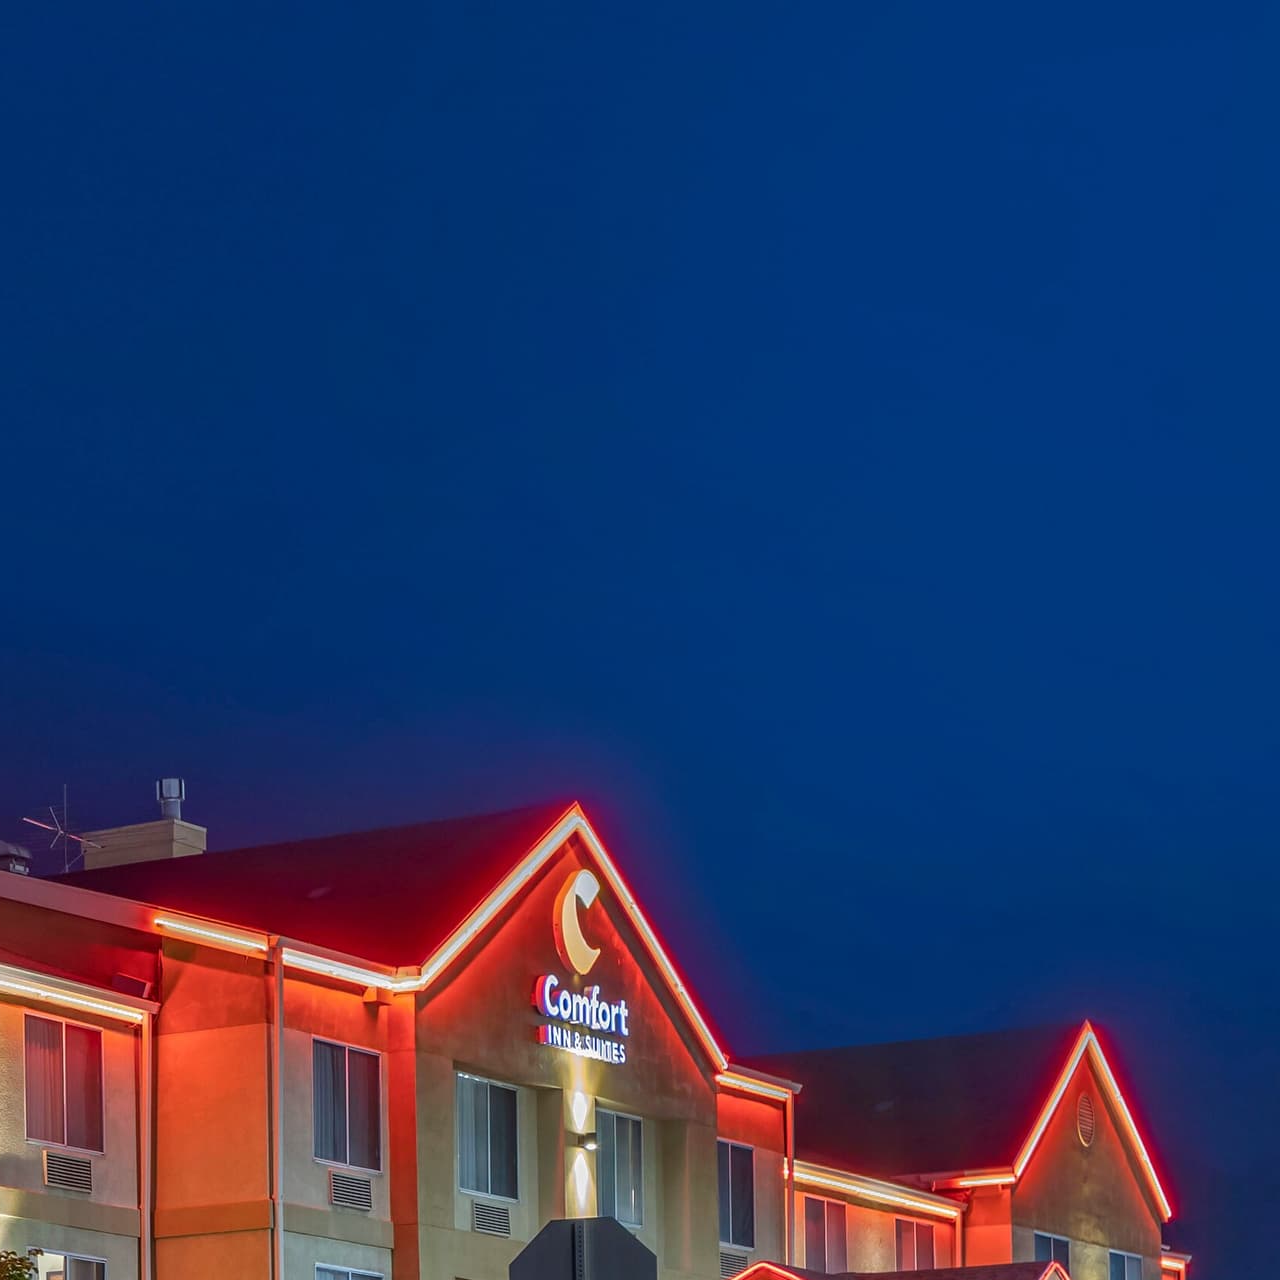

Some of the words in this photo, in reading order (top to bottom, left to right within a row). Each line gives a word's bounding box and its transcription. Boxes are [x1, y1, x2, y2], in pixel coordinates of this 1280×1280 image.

[543, 974, 629, 1036] Comfort
[548, 1024, 571, 1049] INN
[574, 1031, 583, 1051] &
[585, 1034, 626, 1063] SUITES
